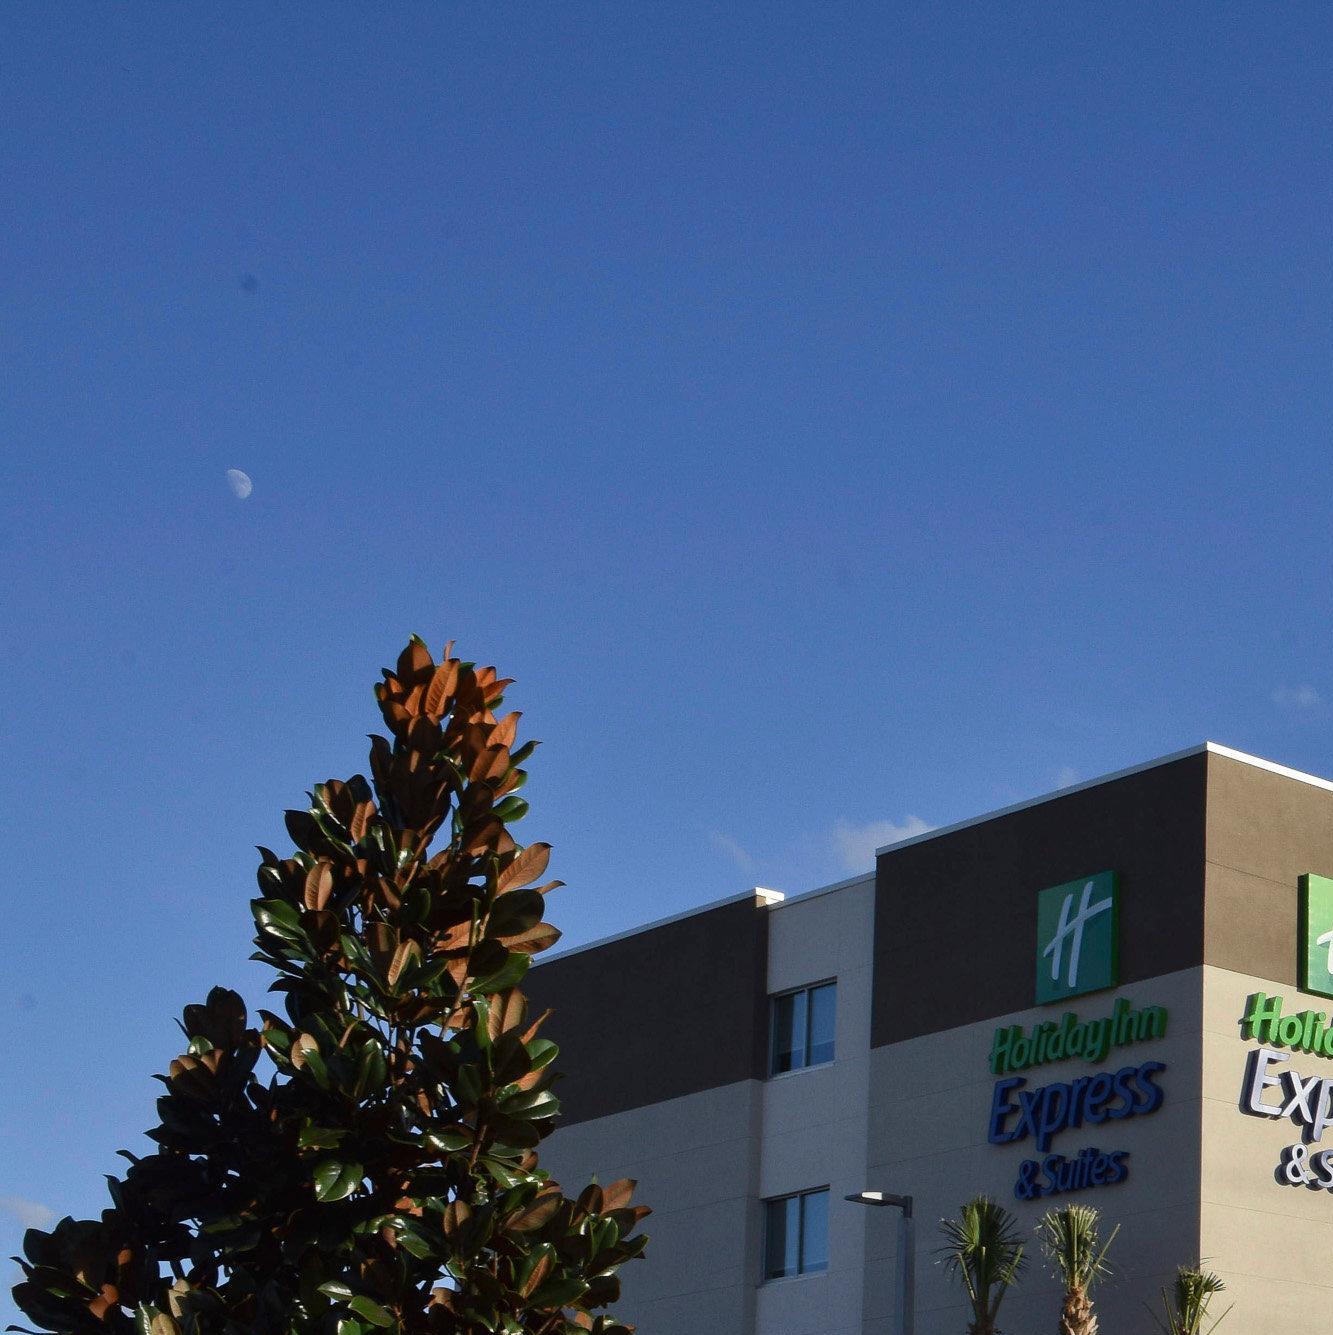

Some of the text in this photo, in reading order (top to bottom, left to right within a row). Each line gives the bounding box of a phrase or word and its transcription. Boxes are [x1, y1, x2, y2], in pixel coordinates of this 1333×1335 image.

[989, 998, 1167, 1074] Holiday Inn
[988, 1061, 1167, 1152] Express
[1014, 1147, 1130, 1200] & Suites
[1281, 1143, 1309, 1185] &
